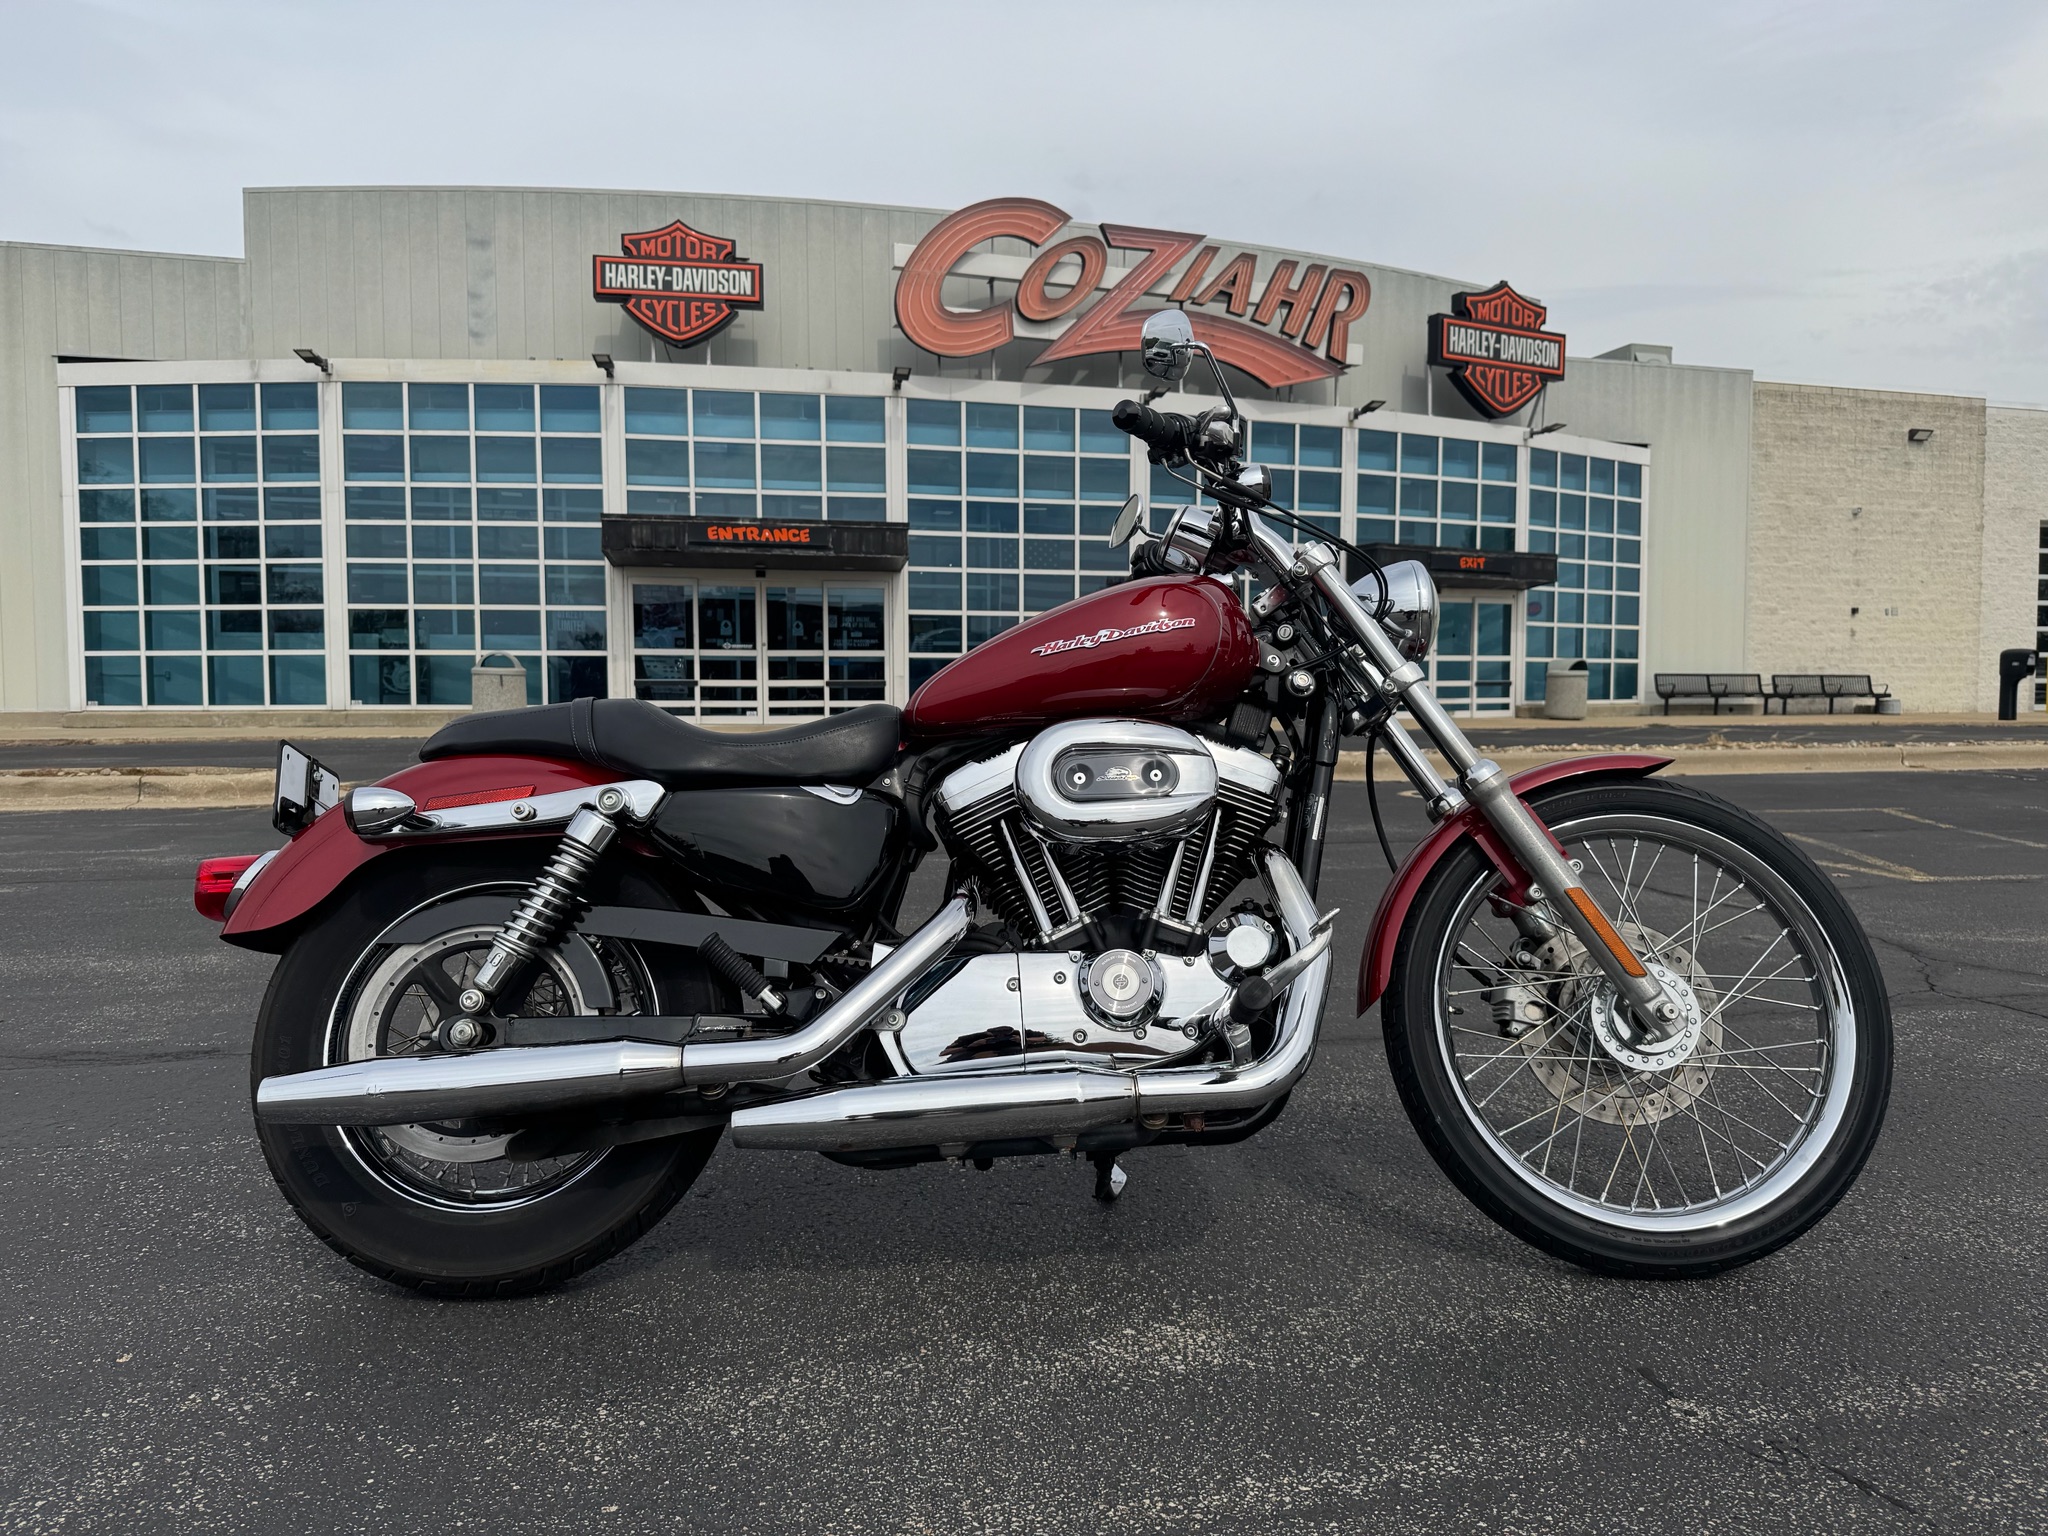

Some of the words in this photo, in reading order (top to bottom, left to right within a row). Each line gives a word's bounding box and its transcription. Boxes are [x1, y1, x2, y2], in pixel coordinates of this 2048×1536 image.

[640, 230, 717, 260] MOTOR
[604, 263, 752, 295] HARLEY-DAVIDSON
[640, 299, 717, 332] CYCLES
[1477, 294, 1535, 329] MOTOR
[1449, 325, 1559, 369] HARLEY-DAVIDSON
[1475, 366, 1532, 403] CYCLES
[707, 525, 811, 543] ENTRANCE
[1459, 557, 1486, 569] EXIT
